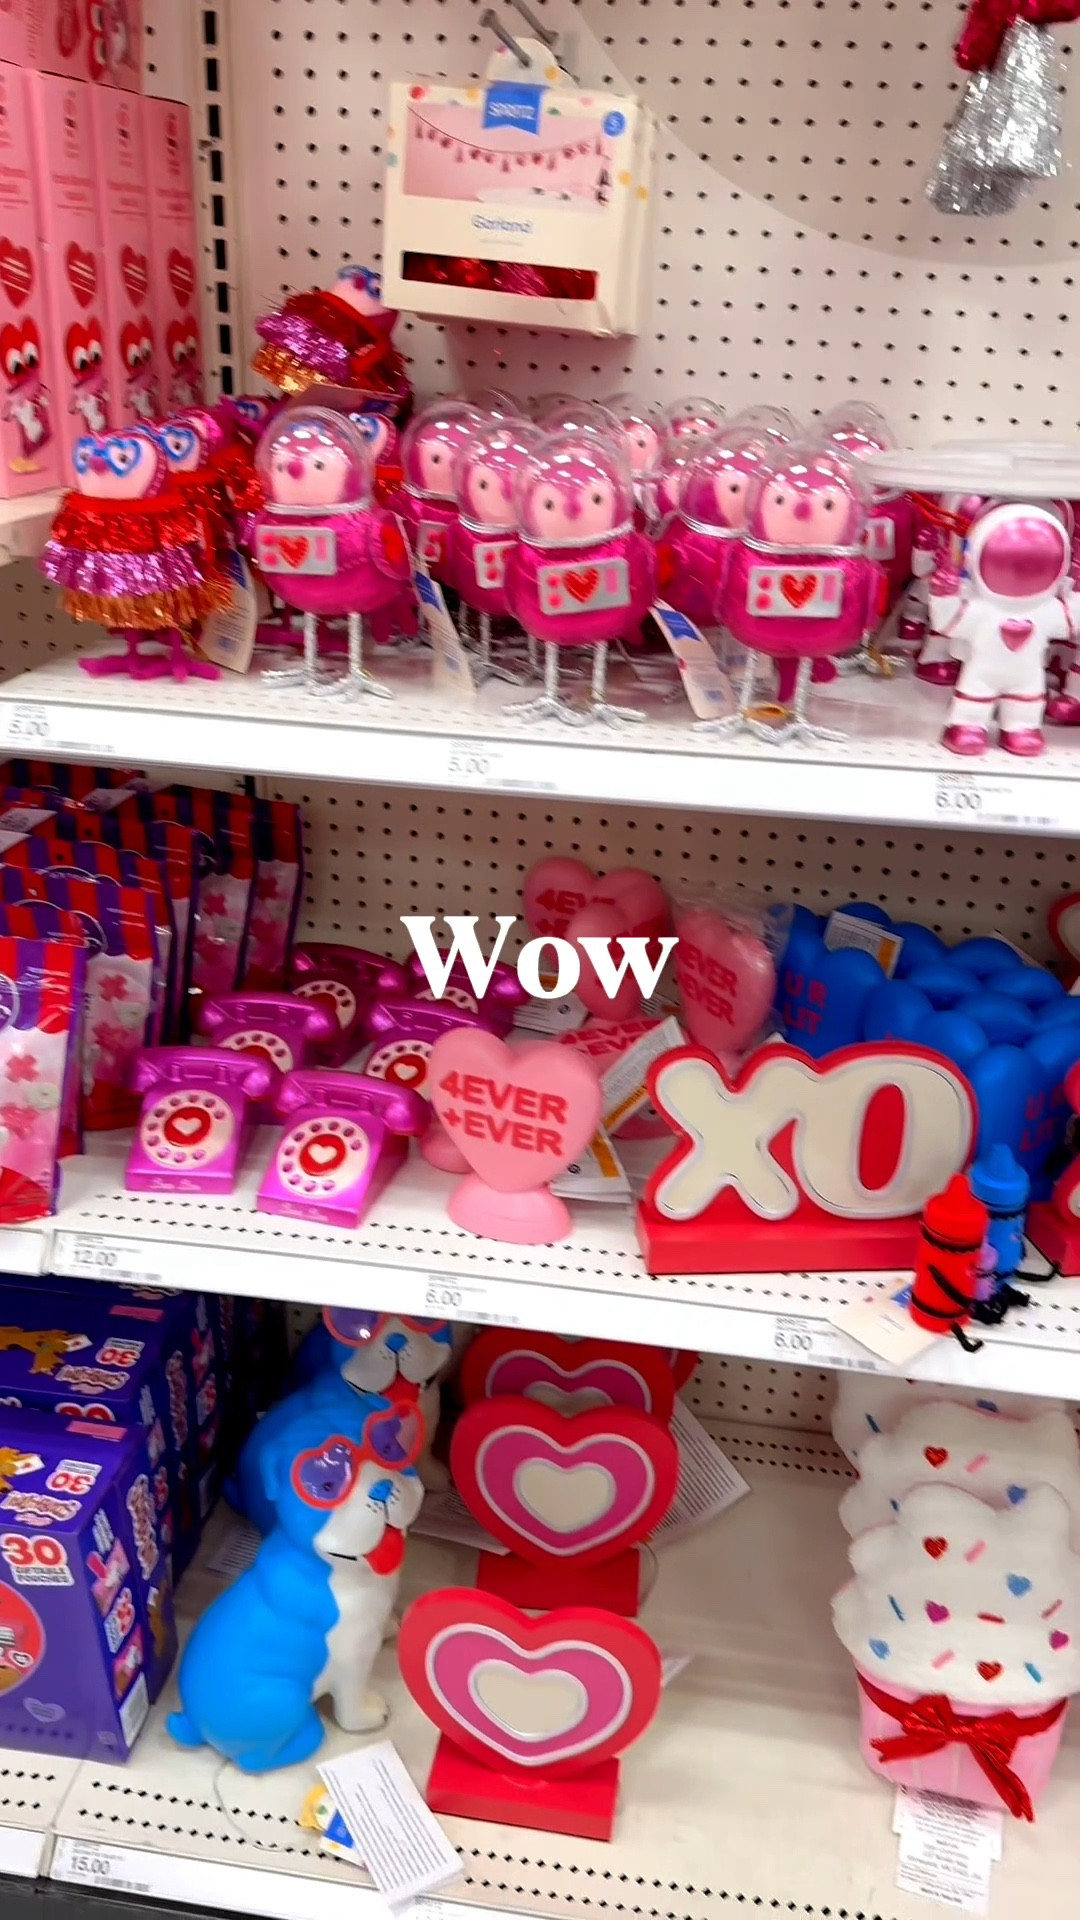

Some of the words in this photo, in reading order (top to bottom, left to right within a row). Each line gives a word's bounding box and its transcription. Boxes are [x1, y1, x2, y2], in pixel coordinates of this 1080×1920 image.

[472, 215, 532, 233] Garland
[935, 791, 982, 810] 6.00
[439, 1070, 569, 1125] 4EVER
[441, 1107, 565, 1158] +EVER
[73, 1249, 118, 1267] 12.00
[425, 1288, 462, 1307] 6.00
[774, 1332, 813, 1351] 6.00
[51, 1472, 92, 1493] 30
[4, 1536, 62, 1567] 30
[70, 1856, 111, 1876] 15.00
